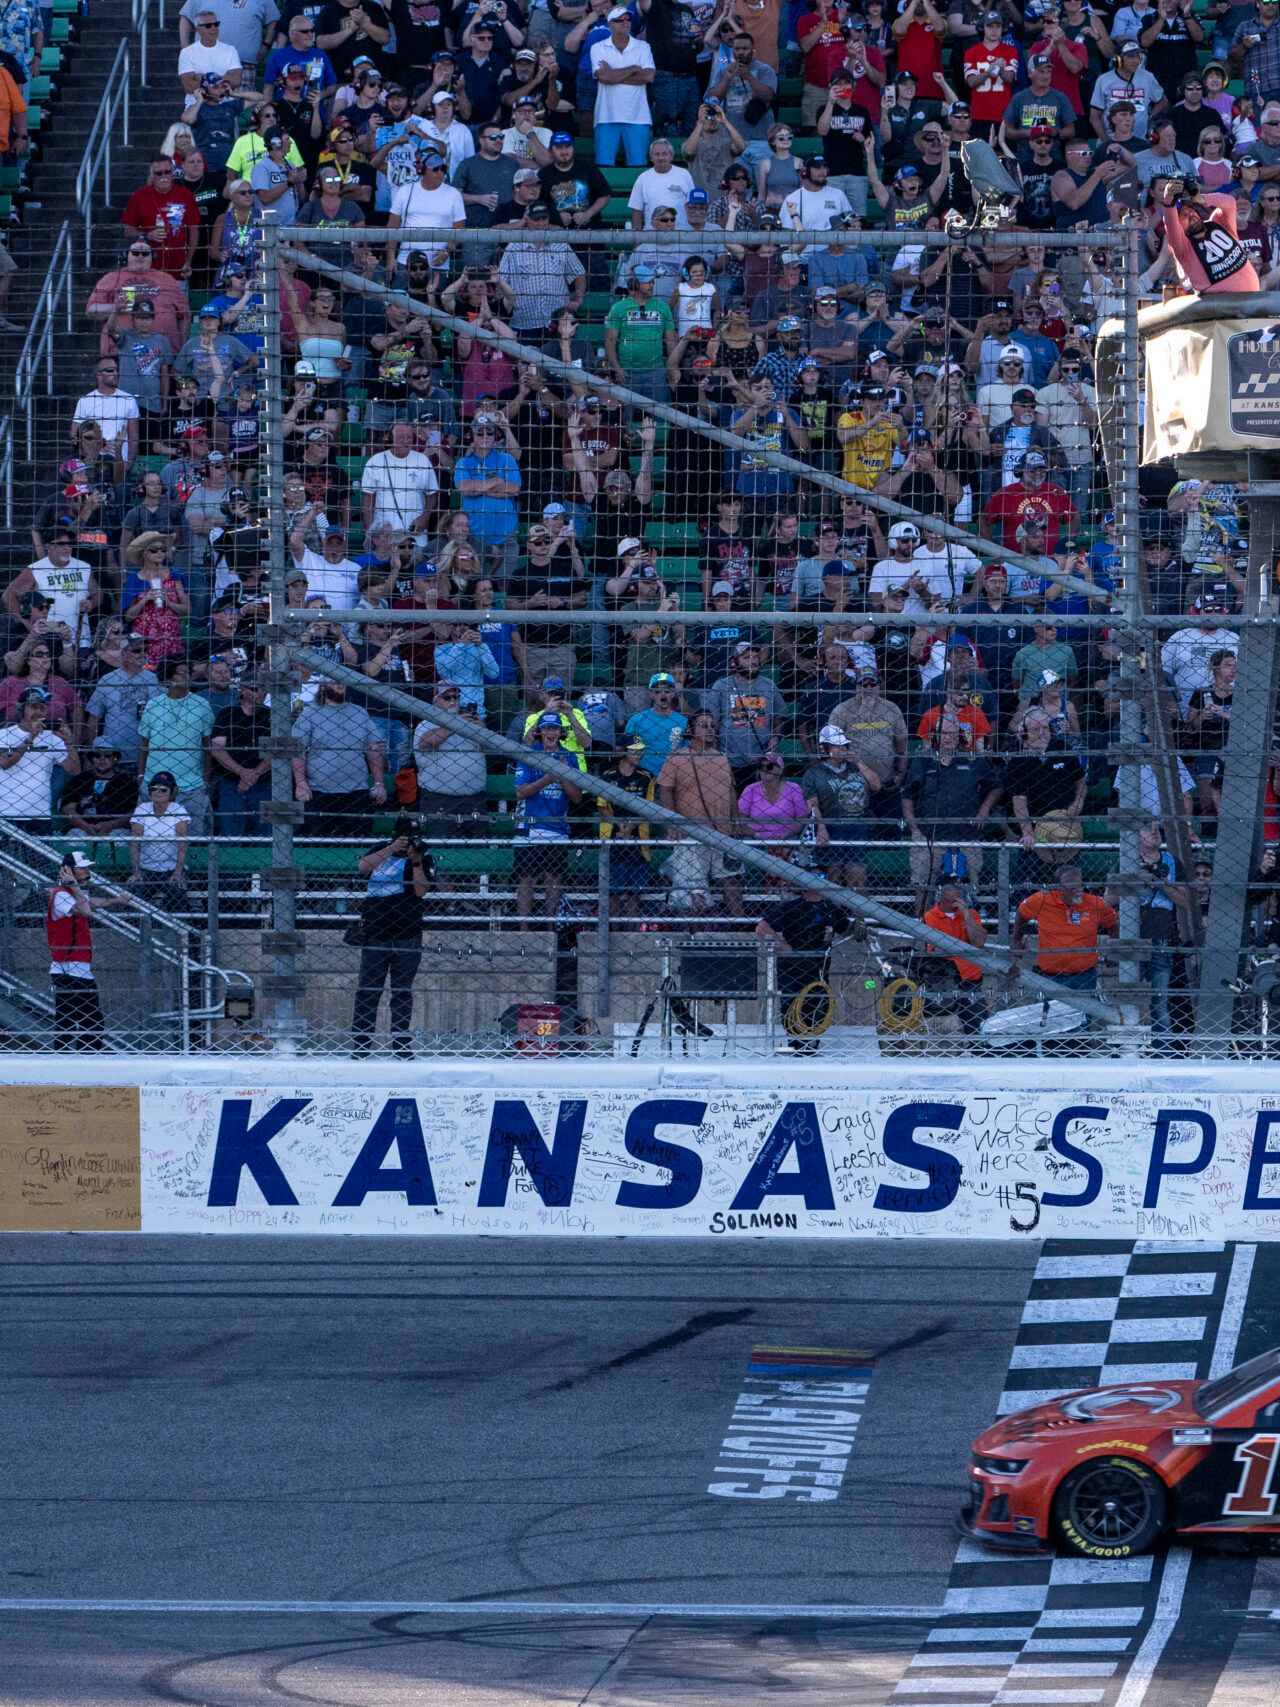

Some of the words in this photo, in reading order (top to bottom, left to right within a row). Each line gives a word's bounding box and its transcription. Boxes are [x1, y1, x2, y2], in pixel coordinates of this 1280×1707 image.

[830, 115, 865, 129] CHASTAIN
[47, 571, 83, 586] BYRON
[537, 1023, 552, 1035] 32
[1261, 1099, 1276, 1108] Free
[822, 1105, 876, 1141] Craig
[969, 1097, 1052, 1136] Jace
[25, 1147, 49, 1165] GO
[41, 1152, 77, 1175] Hamlin
[207, 1098, 967, 1213] KANSAS
[979, 1152, 1030, 1174] Here
[229, 1209, 264, 1226] POPPY
[994, 1181, 1041, 1234] #5
[452, 1213, 529, 1232] Hudson
[709, 1212, 798, 1234] SOLAMON
[707, 1376, 871, 1502] PLAYOFFS
[1076, 1440, 1149, 1454] GOODYEAR
[1062, 1519, 1131, 1557] GOODYEAR
